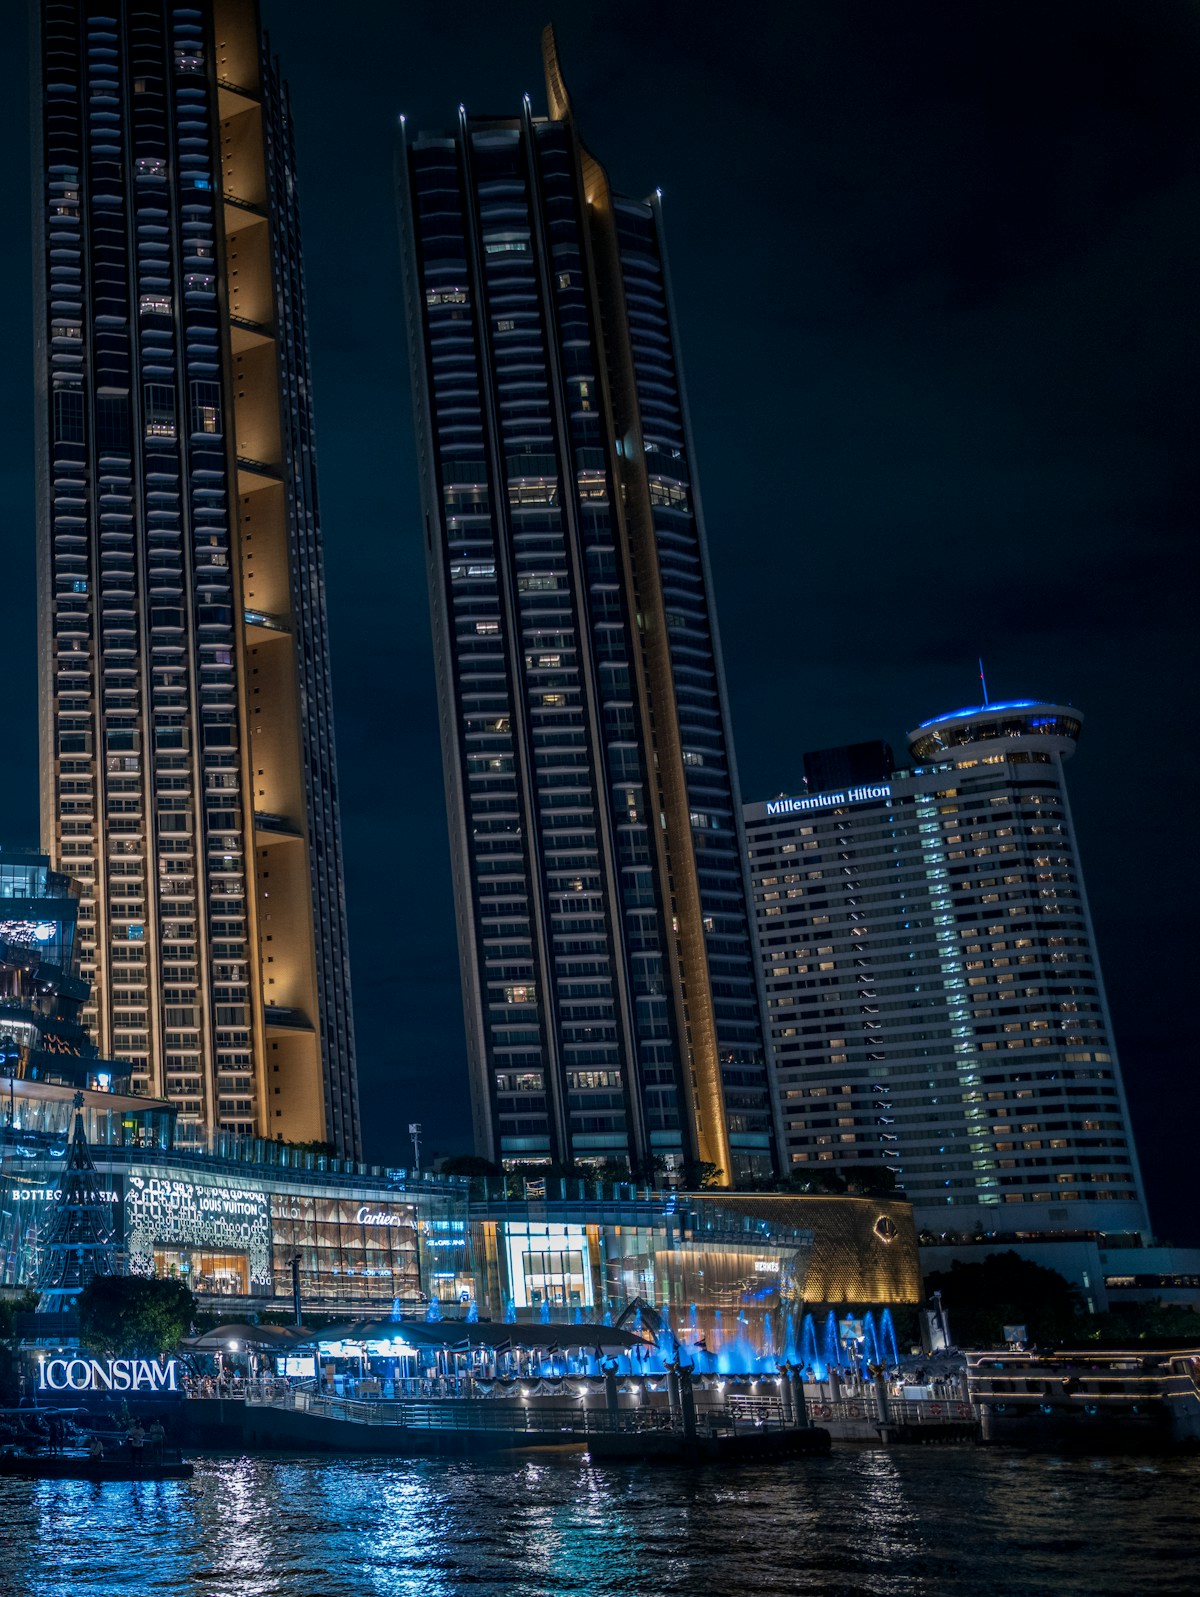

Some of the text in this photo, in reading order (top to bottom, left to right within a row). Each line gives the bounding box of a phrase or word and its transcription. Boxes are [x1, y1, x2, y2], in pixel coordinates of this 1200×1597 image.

[767, 785, 890, 814] Millennium Hilton
[200, 1199, 257, 1215] LOUIS VUITTON
[357, 1207, 397, 1225] Cartier
[38, 1359, 178, 1391] ICONSIAM
